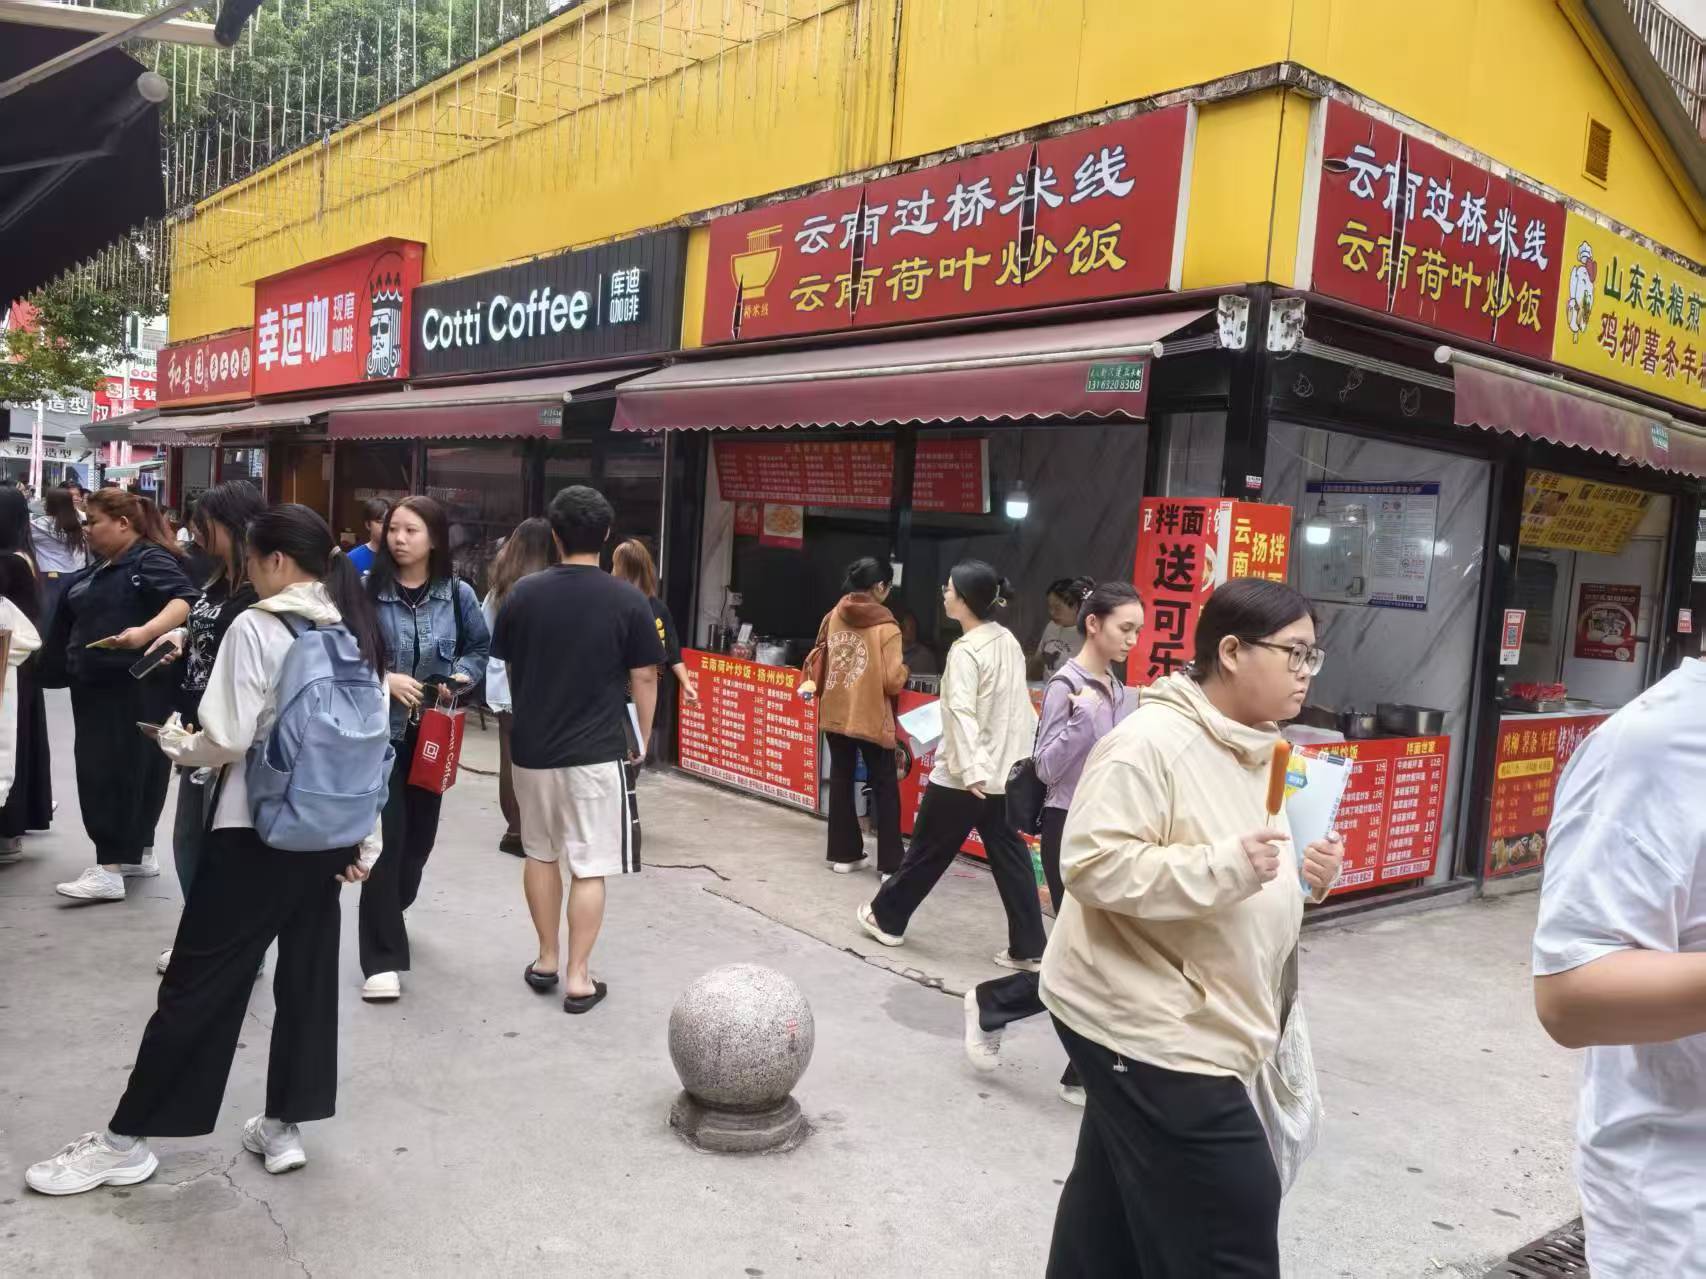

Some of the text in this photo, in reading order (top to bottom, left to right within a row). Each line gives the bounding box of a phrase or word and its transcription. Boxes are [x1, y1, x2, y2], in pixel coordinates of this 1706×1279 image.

[794, 143, 1136, 255] 云南过桥米线
[1346, 144, 1550, 273] 云南过桥米线
[610, 266, 640, 297] 库迪
[789, 221, 1128, 313] 云南荷叶炒饭
[1338, 220, 1543, 333] 云南荷叶炒饭
[1604, 256, 1706, 336] 山东杂粮煎
[257, 296, 329, 371] 幸运咖
[331, 326, 354, 354] 咖啡
[332, 291, 356, 321] 现磨
[422, 287, 589, 351] Cotti Coffee
[609, 295, 639, 324] 咖啡
[1155, 503, 1206, 537] 拌面
[1146, 543, 1195, 678] 送可乐
